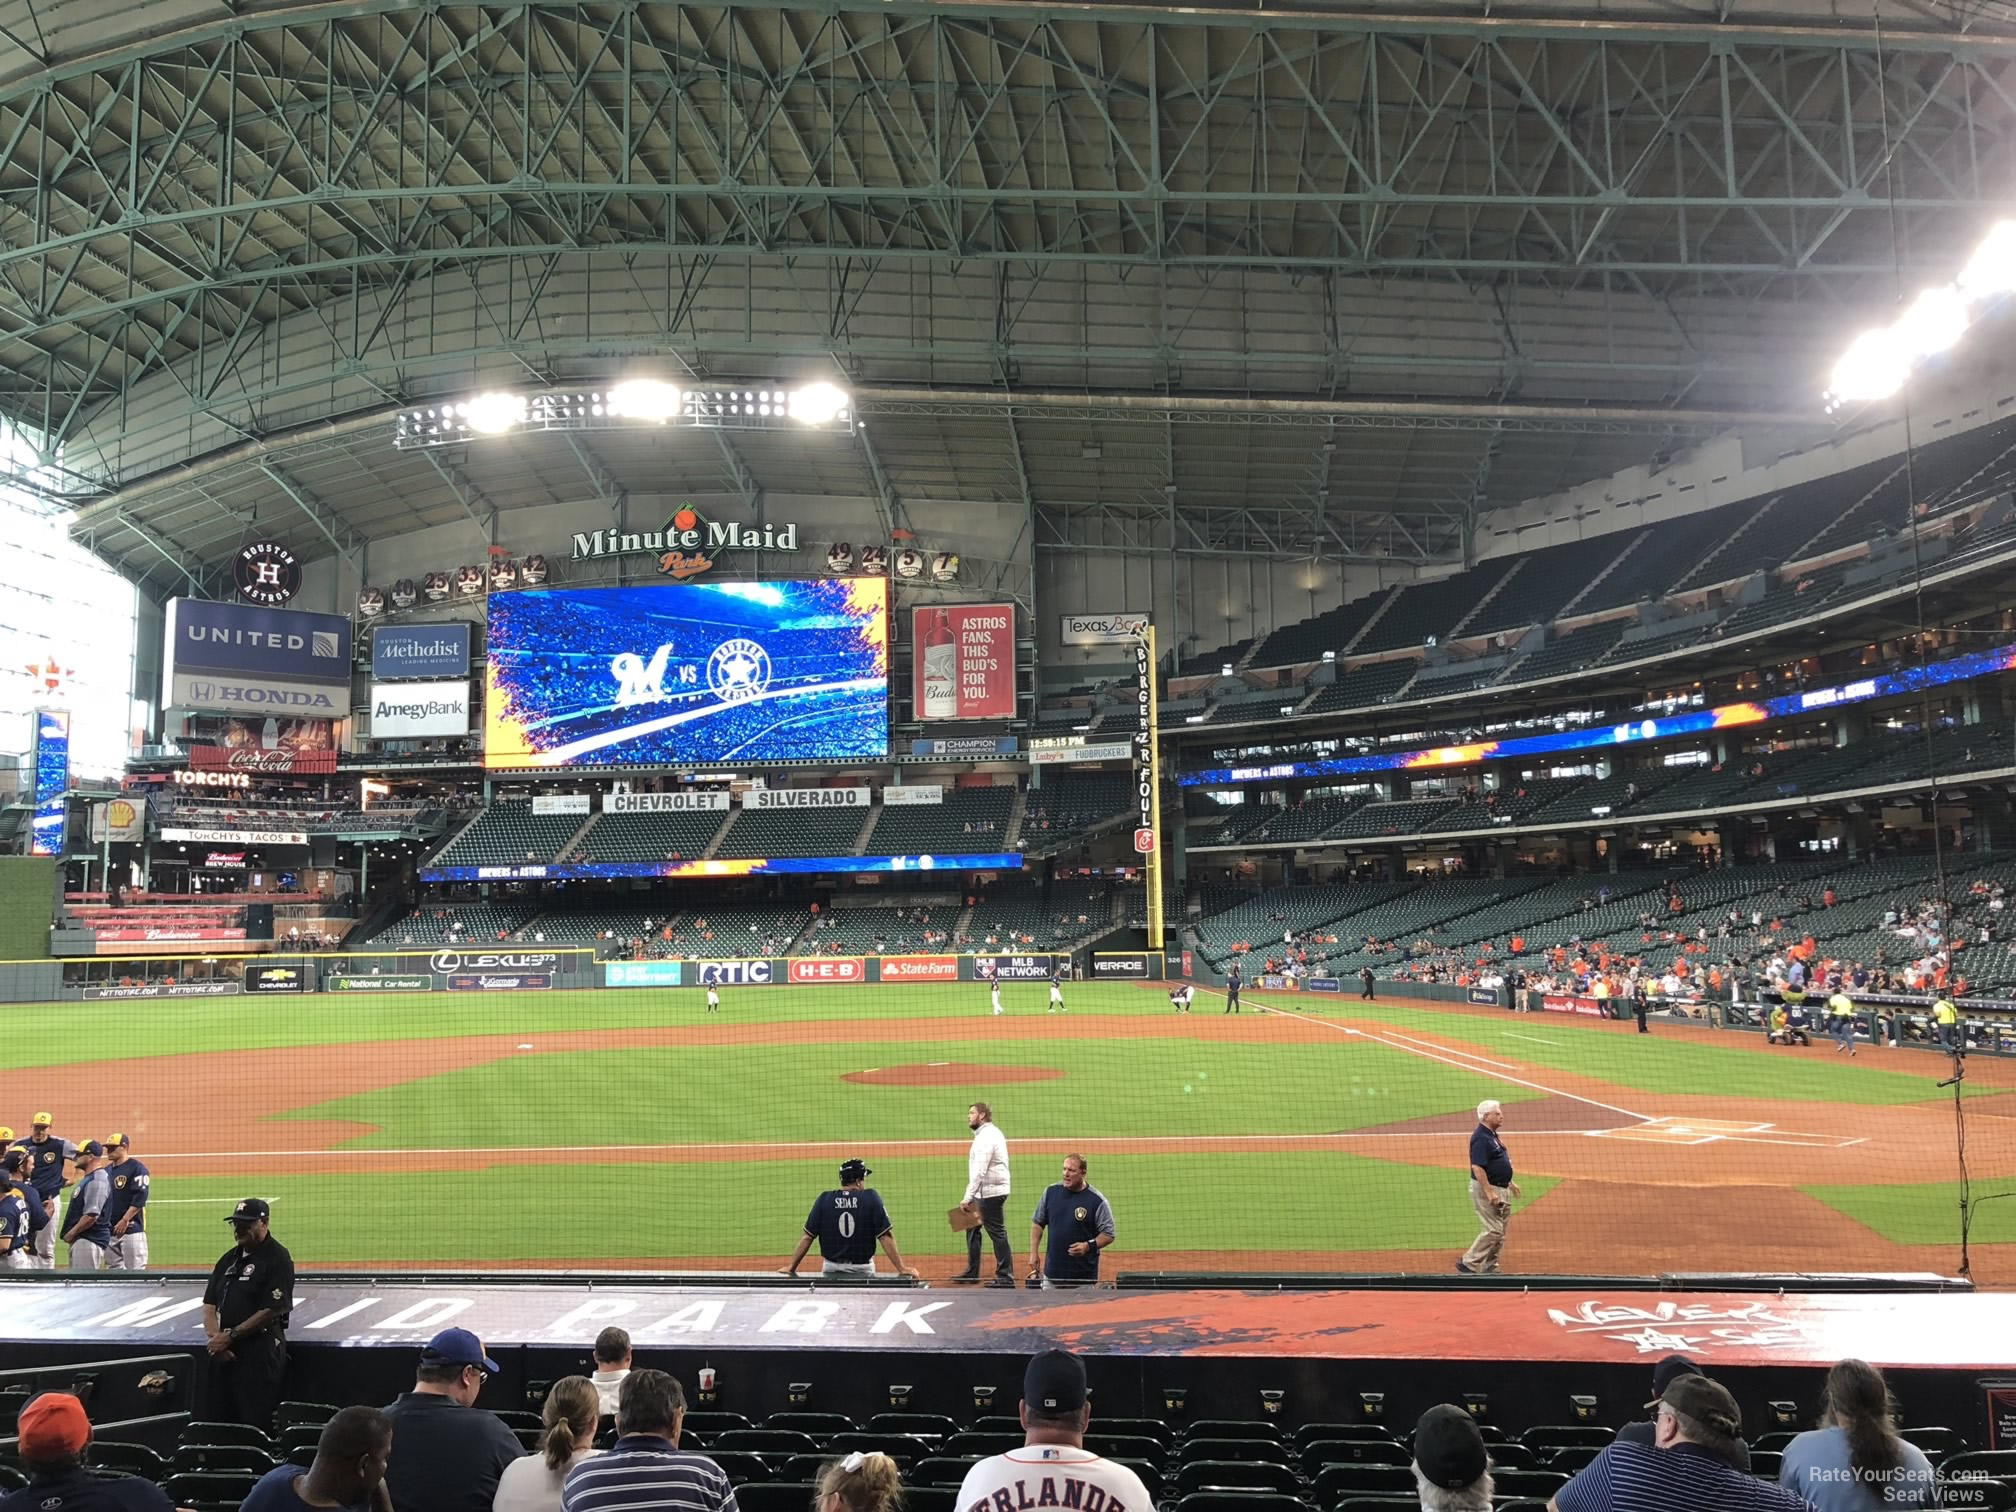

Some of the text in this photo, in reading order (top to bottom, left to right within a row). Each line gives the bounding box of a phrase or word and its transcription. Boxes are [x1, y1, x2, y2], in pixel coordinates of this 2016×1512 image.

[572, 522, 798, 559] Minute Maid
[243, 544, 294, 564] HOUSTON
[828, 542, 851, 560] 49
[862, 545, 886, 562] 24
[904, 549, 915, 565] 5
[491, 559, 513, 577] 34
[523, 554, 545, 572] 42
[658, 551, 711, 574] Park
[939, 552, 950, 569] 7
[425, 572, 446, 589] 25
[458, 565, 479, 582] 33
[244, 584, 290, 602] ASTROS
[393, 579, 413, 597] 40
[962, 617, 1007, 630] ASTROS
[1067, 618, 1108, 632] Texas
[188, 625, 304, 650] UNITED
[962, 631, 994, 645] FANS,
[380, 640, 460, 658] Methodist
[962, 645, 988, 657] THIS
[963, 659, 998, 671] BUD'S
[963, 673, 985, 685] FOR
[219, 686, 334, 708] HONDA
[963, 686, 989, 699] YOU.
[375, 700, 463, 720] AmegyBank
[947, 739, 996, 748] CHAMPION
[1068, 736, 1085, 746] PM
[228, 749, 298, 772] Coca-Cola
[173, 770, 250, 788] TORCHY'S
[615, 794, 718, 811] CHEVROLET
[758, 790, 857, 806] SILVERADO
[249, 832, 284, 842] TACOS
[144, 929, 201, 940] Budweiser
[465, 955, 539, 968] LEXUS
[1012, 957, 1034, 966] MLB
[699, 962, 769, 982] RTIC
[997, 967, 1048, 977] NETWORK
[349, 979, 421, 988] National Car Rental
[834, 1197, 858, 1208] SEDAR
[838, 1211, 855, 1238] 0
[77, 1296, 955, 1336] MID PARK
